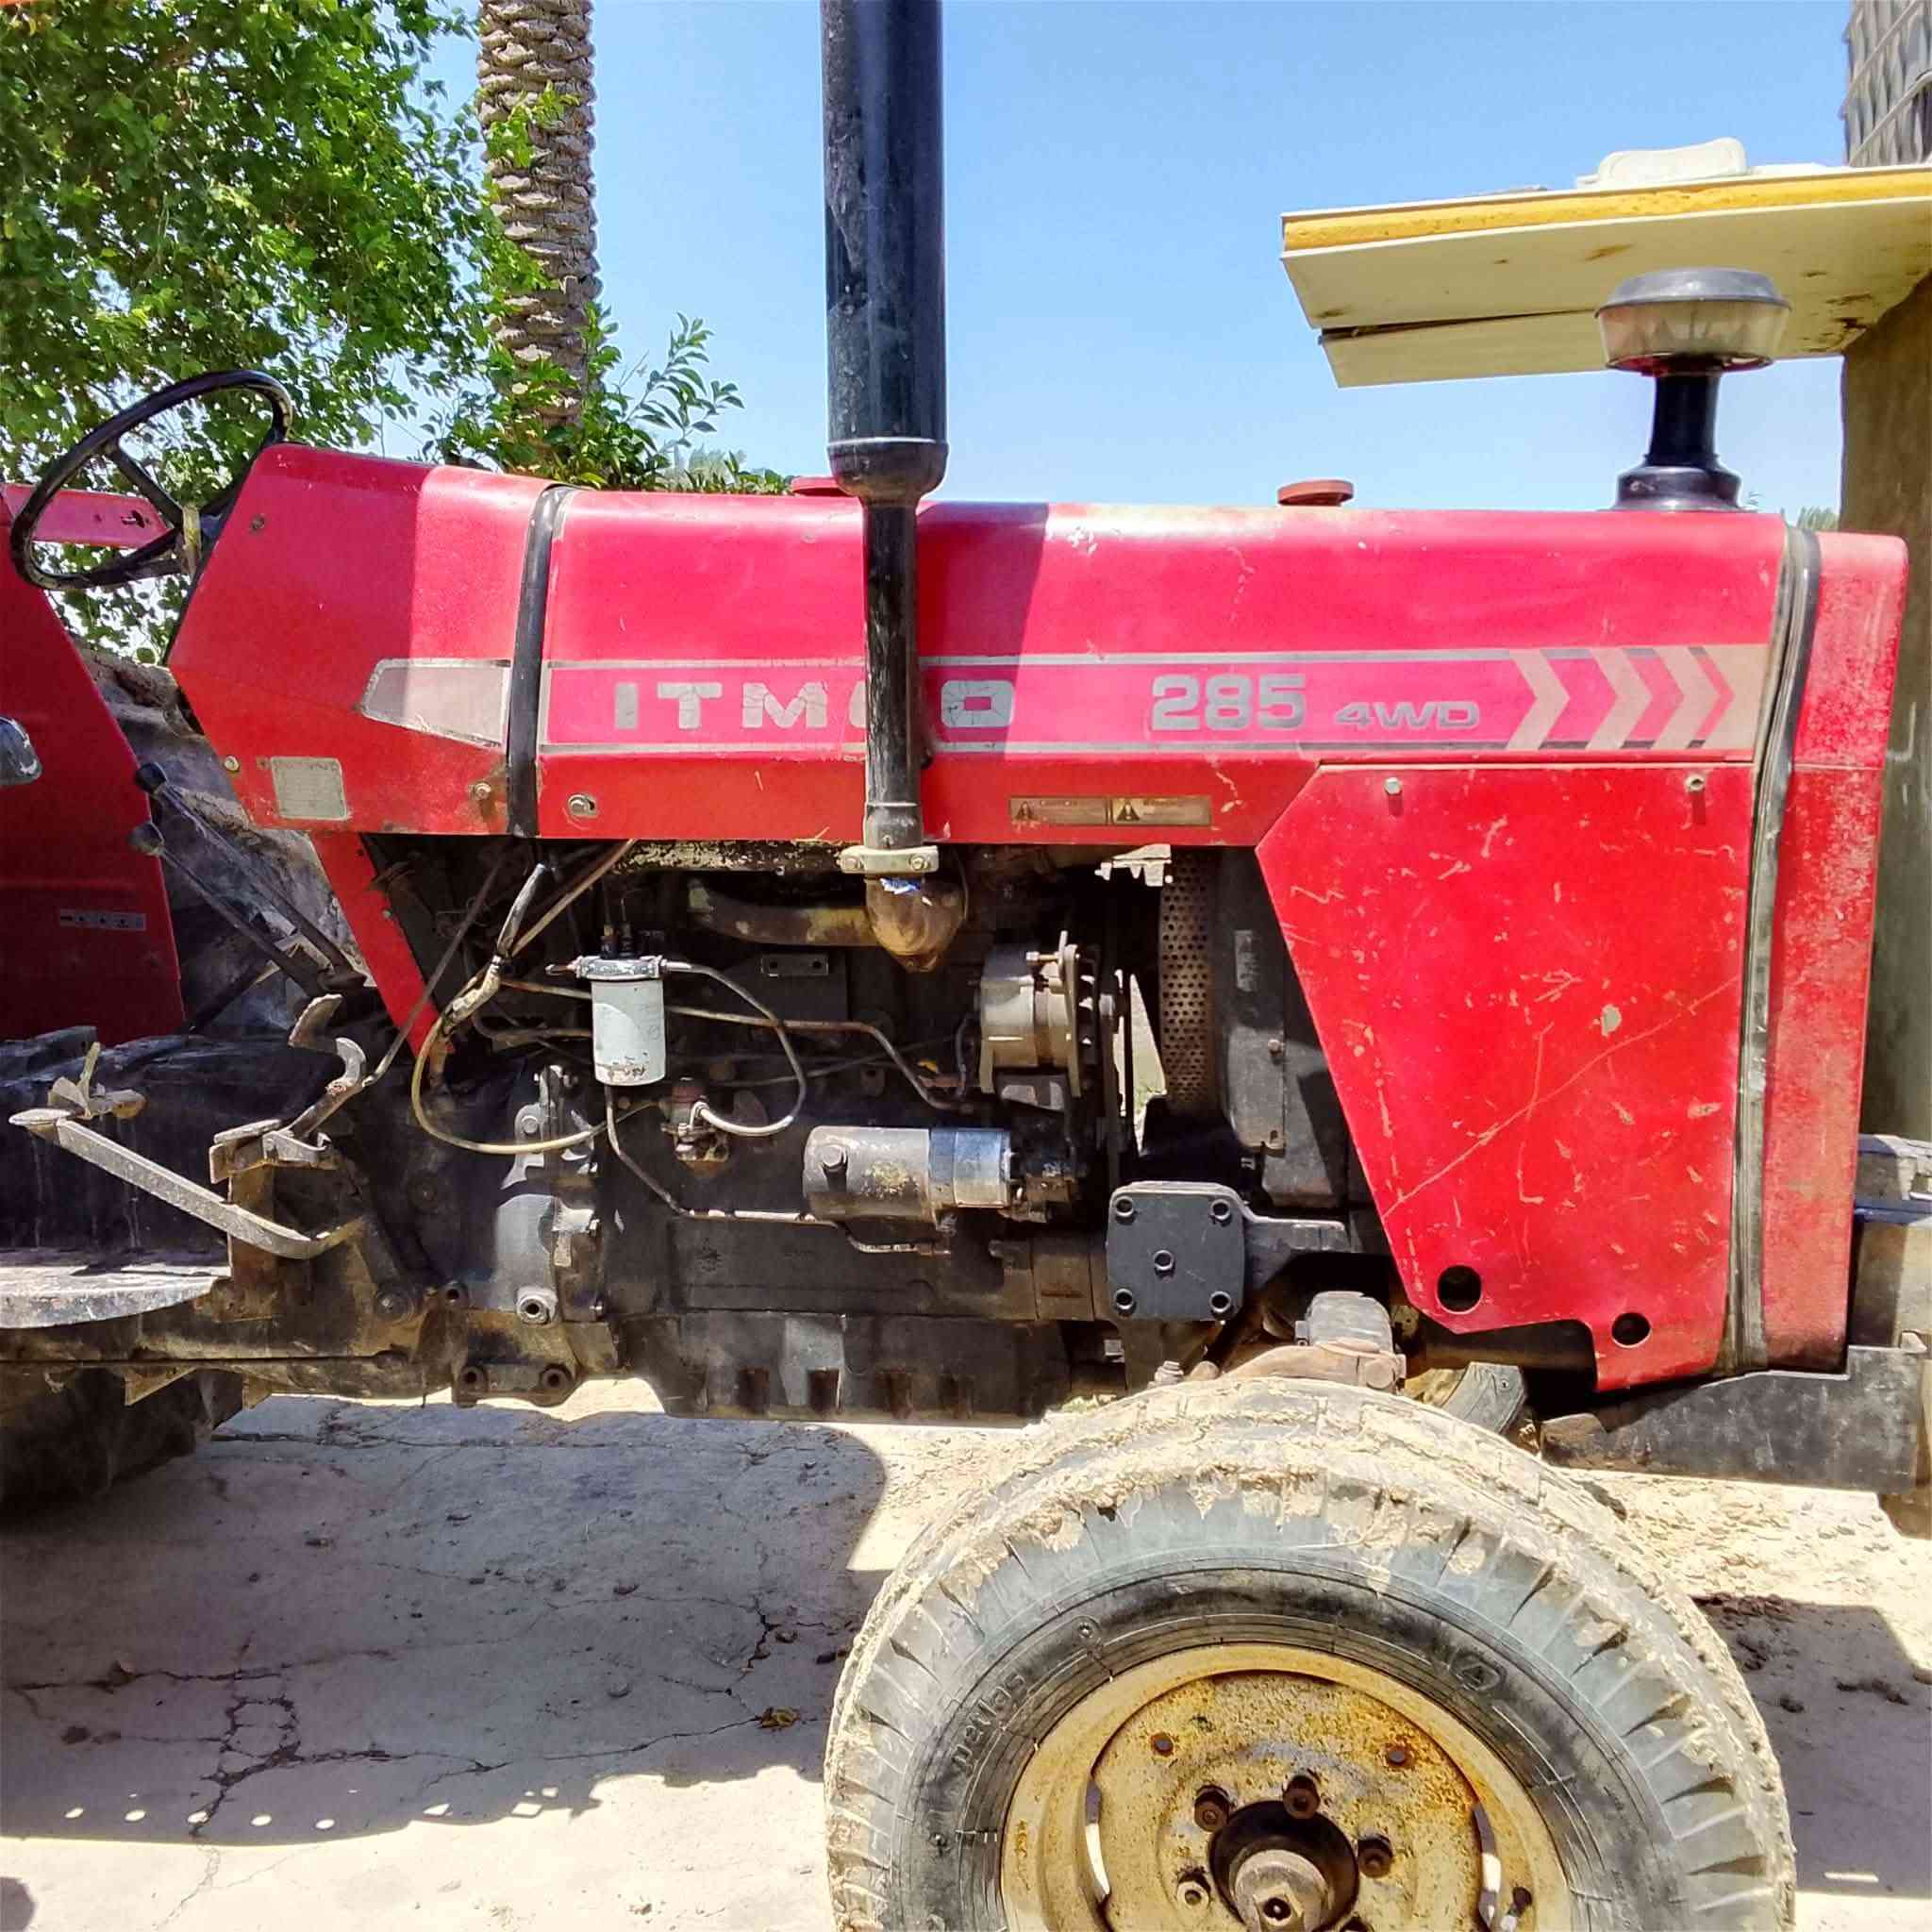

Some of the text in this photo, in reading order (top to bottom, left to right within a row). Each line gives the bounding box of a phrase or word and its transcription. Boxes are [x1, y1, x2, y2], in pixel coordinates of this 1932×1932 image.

[615, 674, 1481, 731] ITMO 285 4WD
